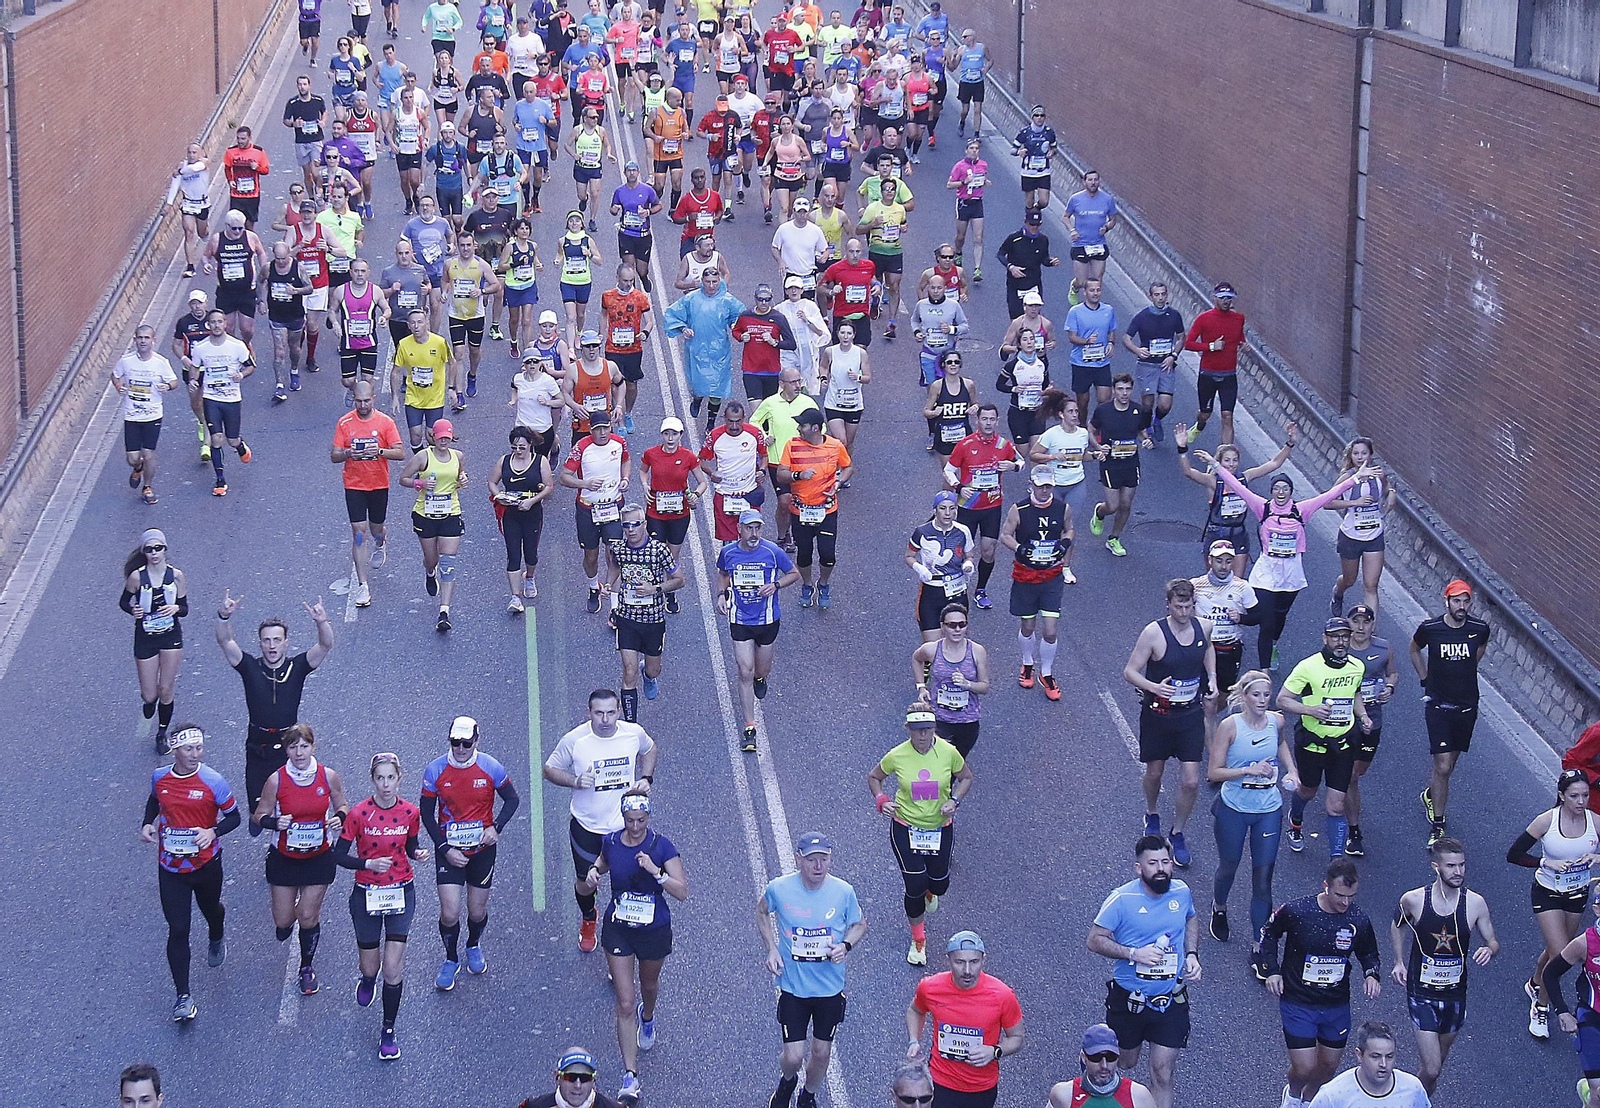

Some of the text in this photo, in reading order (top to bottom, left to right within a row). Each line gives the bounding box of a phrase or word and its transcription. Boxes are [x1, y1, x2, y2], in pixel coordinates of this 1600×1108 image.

[943, 403, 967, 415] RFF
[1038, 517, 1049, 527] N
[1038, 531, 1049, 540] Y
[1440, 643, 1470, 658] PUXA
[1321, 676, 1355, 689] ENERGY
[364, 826, 382, 835] Hola
[628, 894, 651, 902] ZURICH
[952, 1028, 979, 1036] ZURICH
